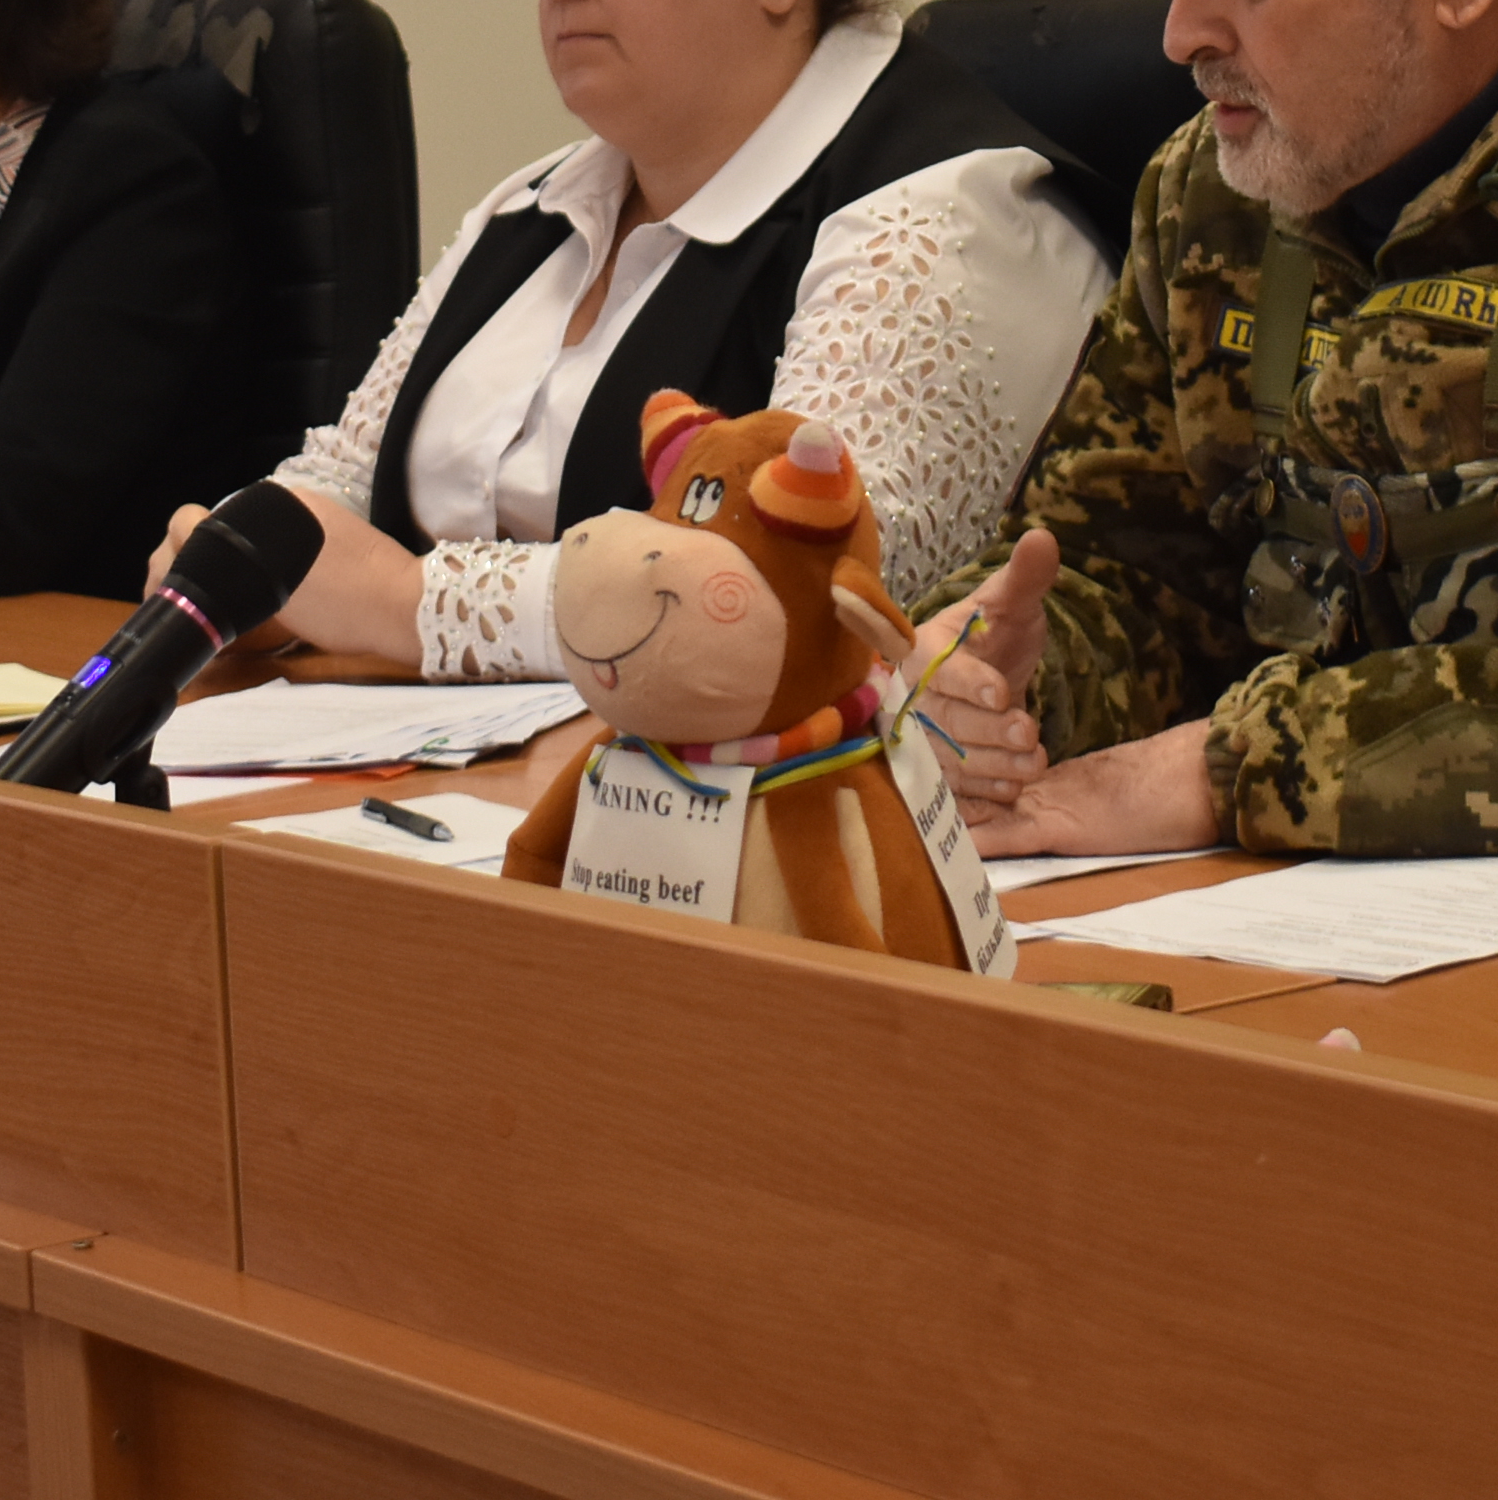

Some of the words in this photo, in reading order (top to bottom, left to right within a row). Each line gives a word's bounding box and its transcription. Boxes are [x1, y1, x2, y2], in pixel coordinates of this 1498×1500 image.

[592, 781, 673, 817] RNING
[571, 857, 593, 893] Stop
[596, 868, 651, 904] eating
[658, 874, 705, 905] beef
